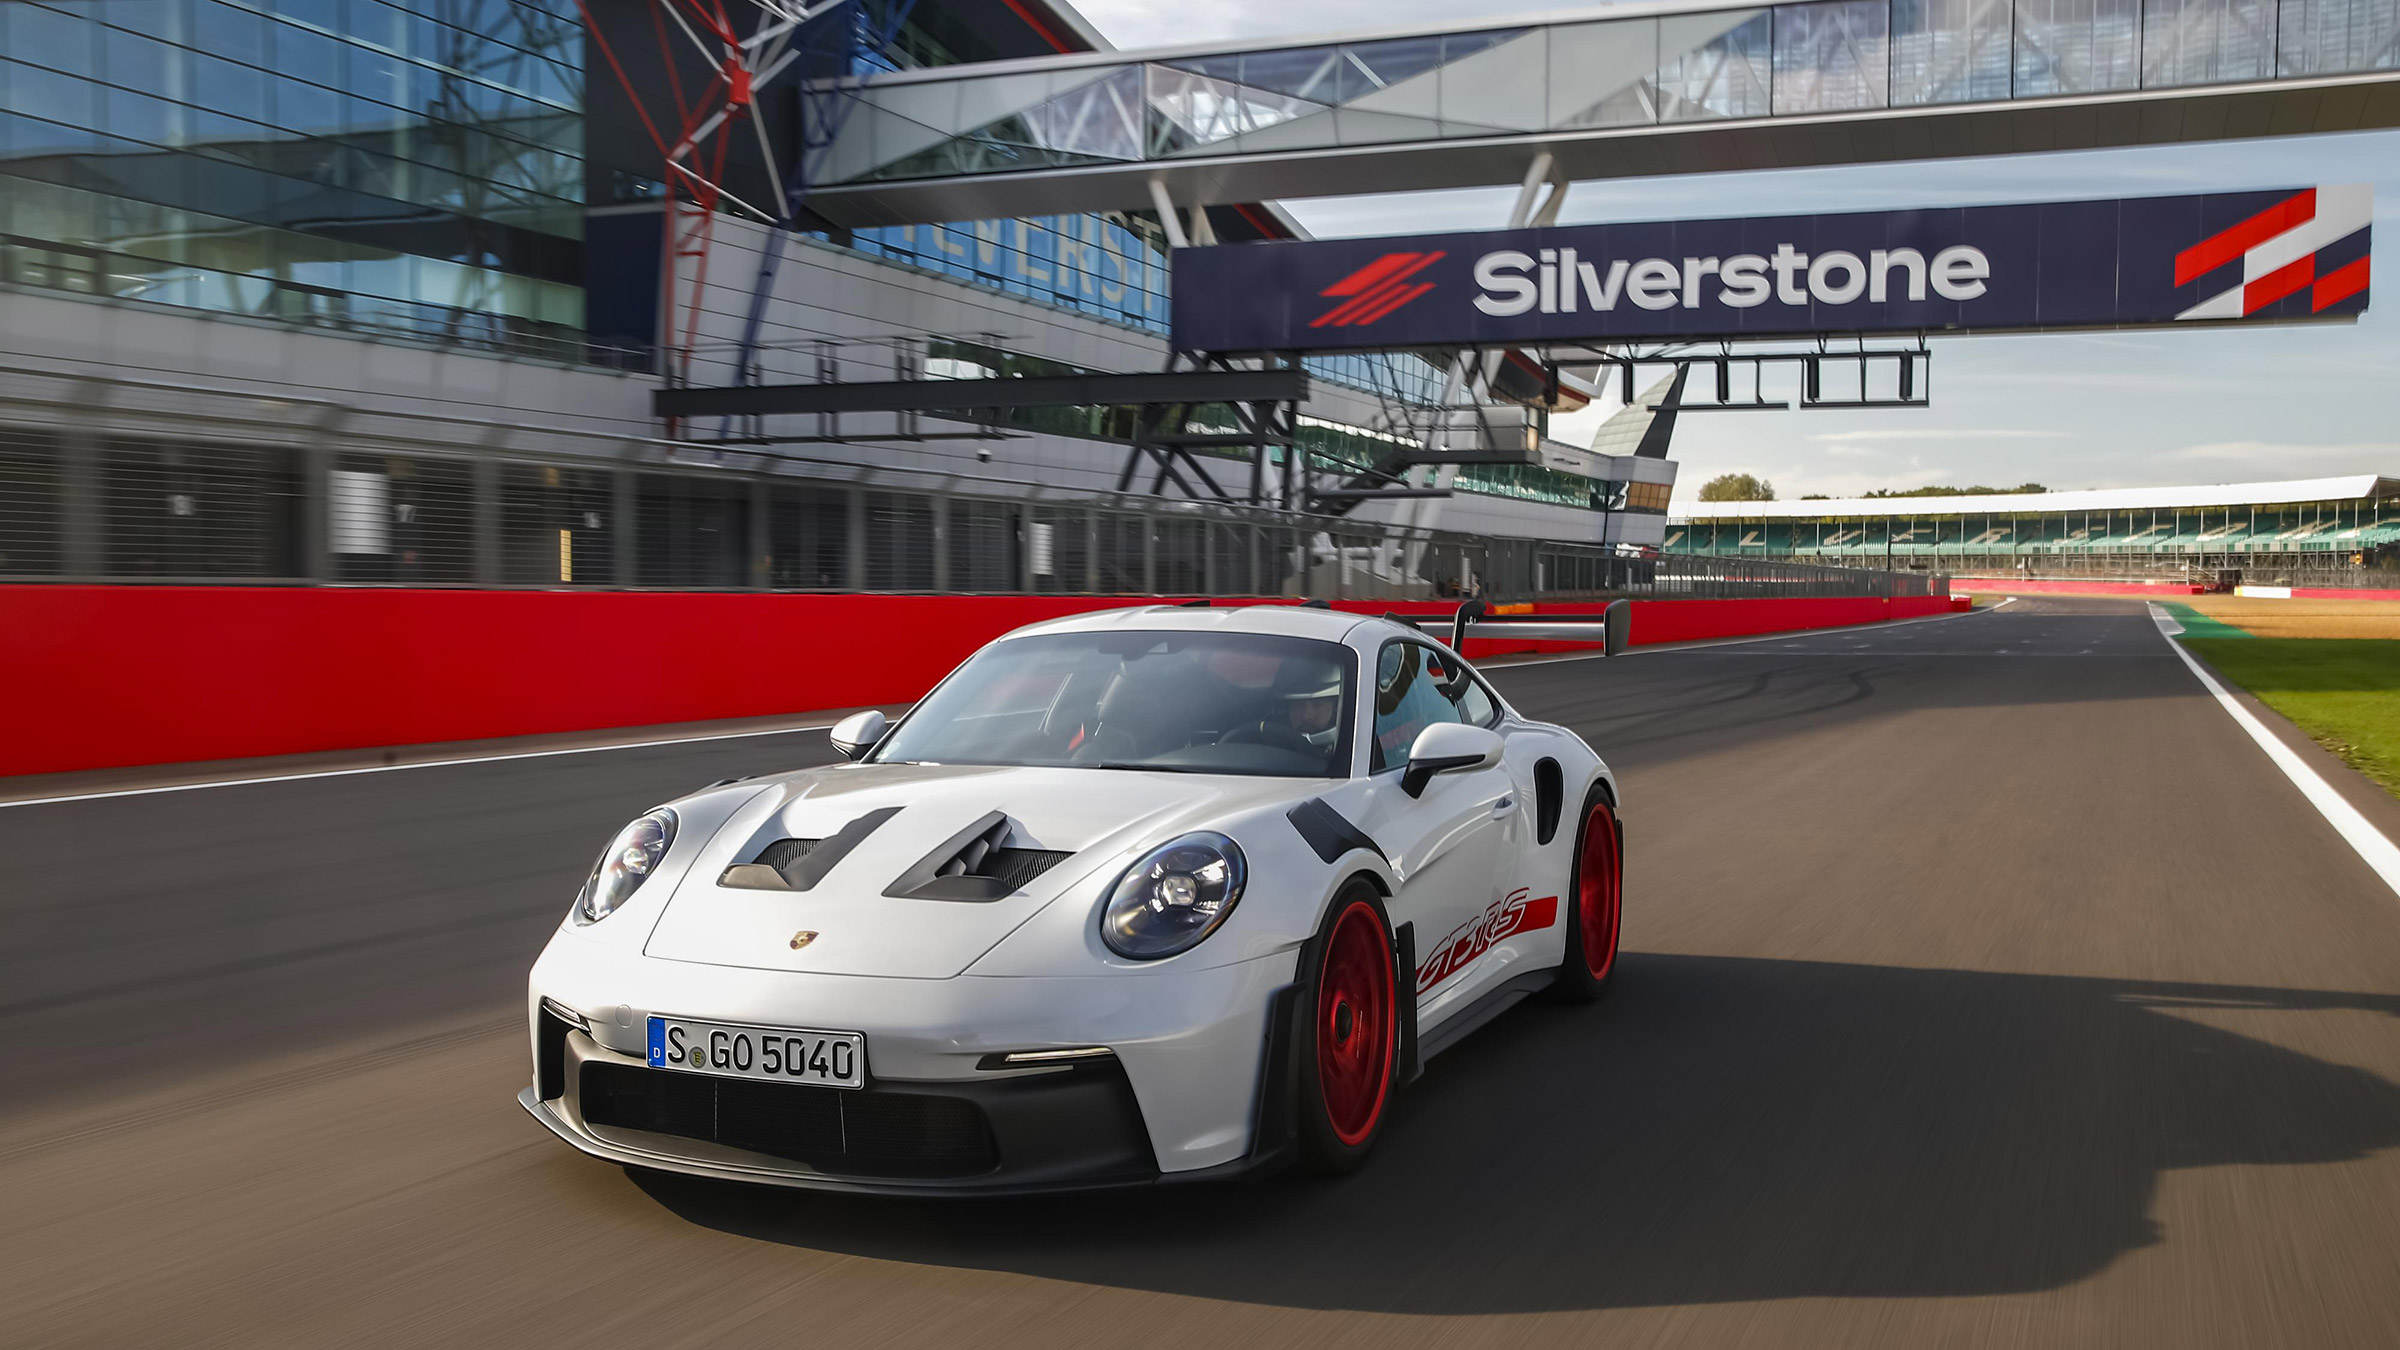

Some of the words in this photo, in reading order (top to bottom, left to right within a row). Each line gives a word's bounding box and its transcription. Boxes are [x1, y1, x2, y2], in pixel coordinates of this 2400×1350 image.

[1472, 243, 1990, 317] Silverstone
[653, 1047, 661, 1059] D
[667, 1026, 686, 1063] S
[709, 1030, 753, 1071] GO
[761, 1035, 853, 1080] 5040
